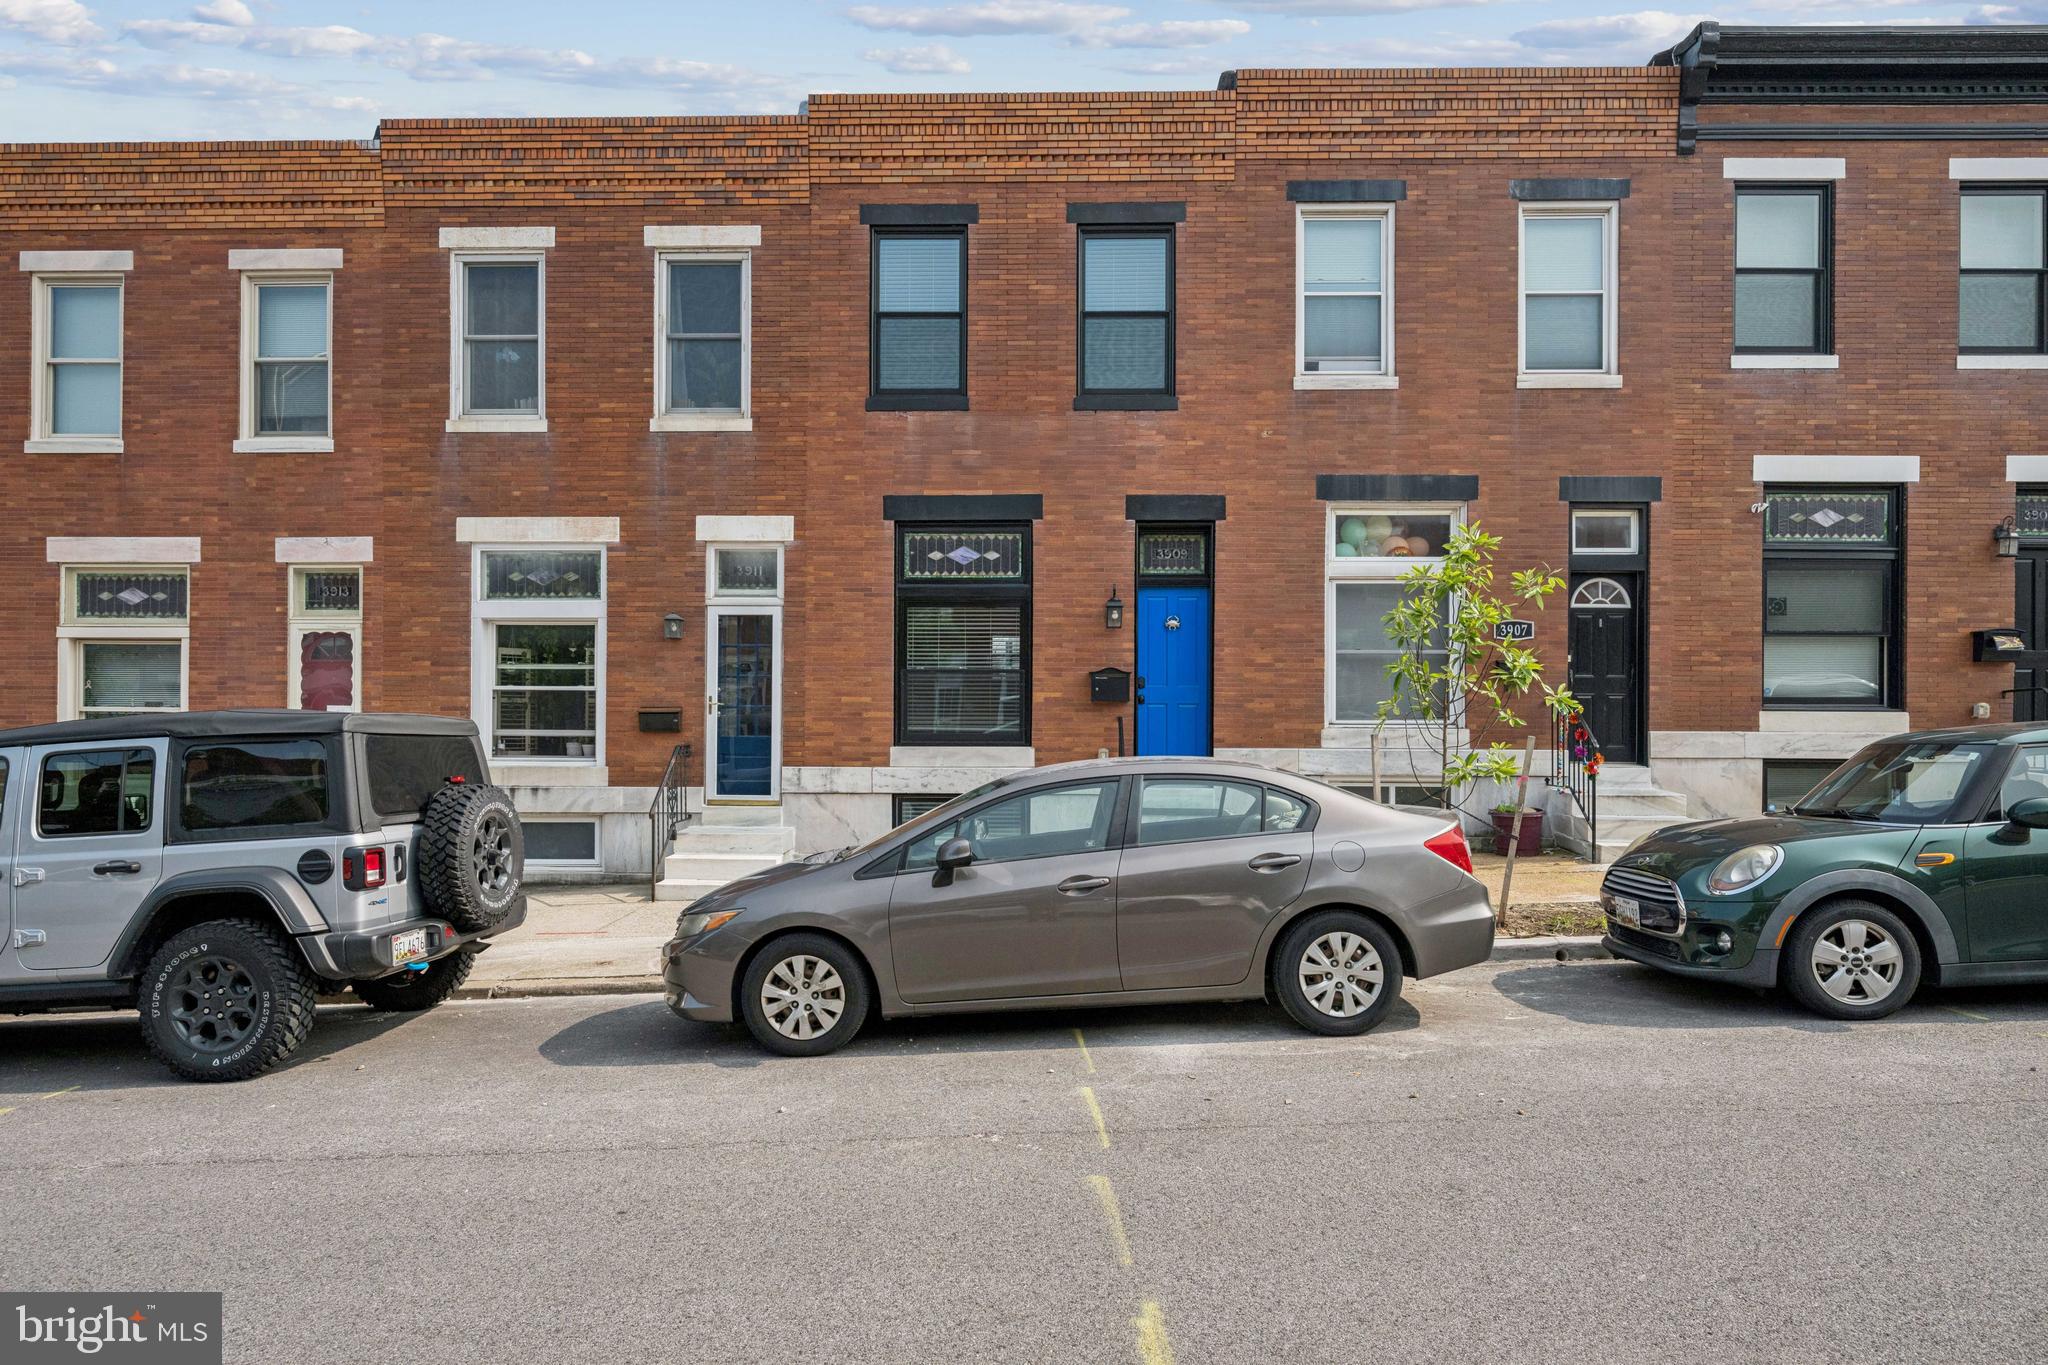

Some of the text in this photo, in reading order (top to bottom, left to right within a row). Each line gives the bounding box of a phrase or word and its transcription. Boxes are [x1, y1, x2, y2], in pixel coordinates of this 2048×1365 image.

[1156, 549, 1188, 559] 3909
[736, 566, 763, 576] 3911
[322, 586, 350, 597] 3913
[1500, 624, 1528, 636] 3907
[222, 991, 270, 1064] DESTINATION
